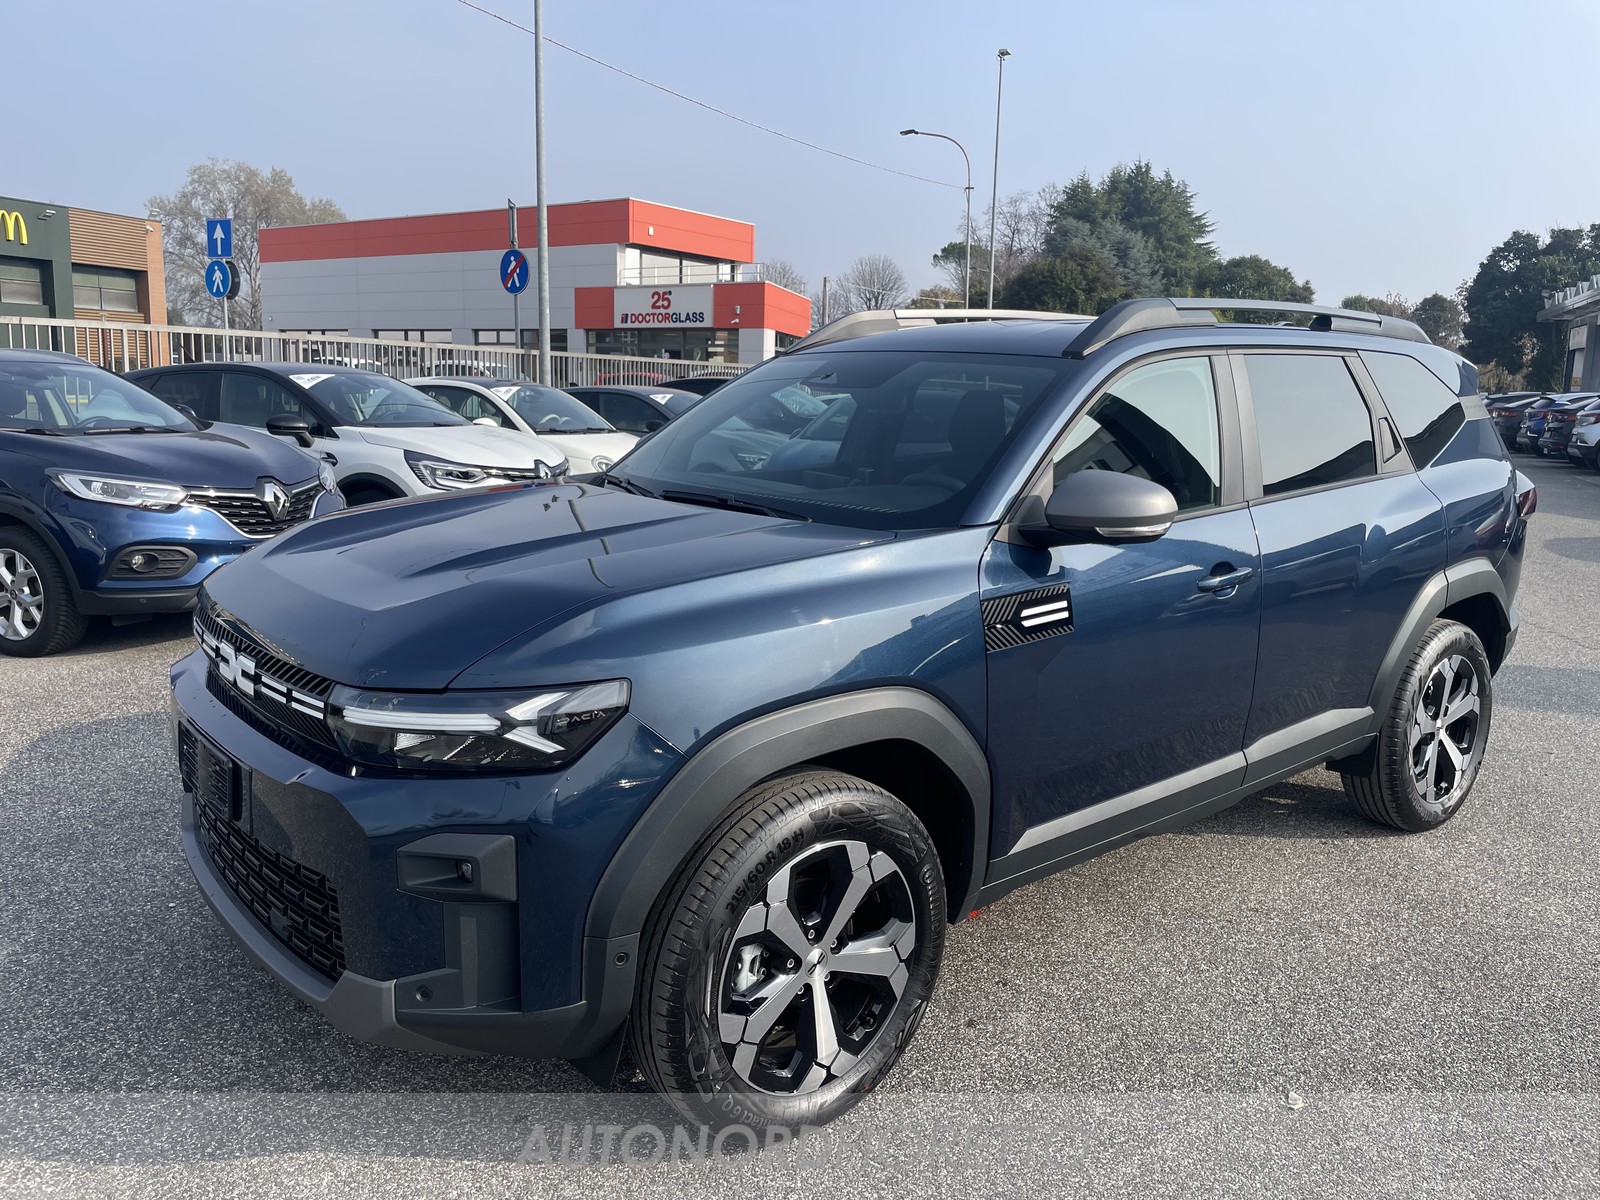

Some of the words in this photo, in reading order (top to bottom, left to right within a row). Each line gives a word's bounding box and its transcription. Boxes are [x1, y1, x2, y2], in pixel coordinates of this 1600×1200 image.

[630, 312, 705, 324] DOCTORGLASS
[765, 850, 778, 865] R
[776, 837, 792, 855] 18
